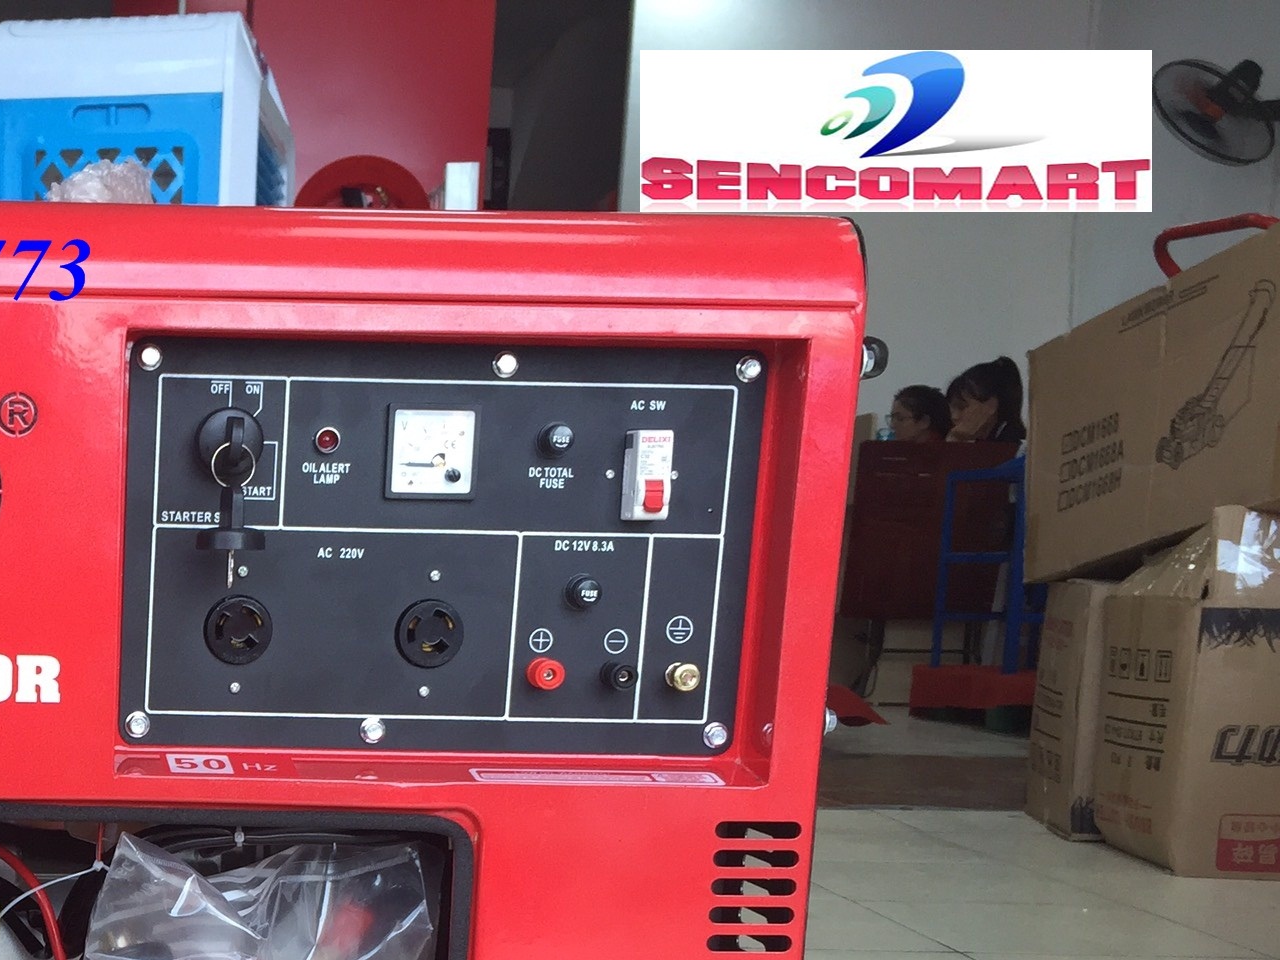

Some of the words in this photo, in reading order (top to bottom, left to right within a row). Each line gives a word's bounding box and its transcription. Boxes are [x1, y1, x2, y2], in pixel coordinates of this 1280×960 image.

[210, 383, 230, 395] OFF
[245, 384, 261, 395] ON
[630, 399, 646, 411] AC
[648, 399, 667, 411] SW
[552, 434, 571, 444] FUSE
[302, 462, 318, 474] OIL
[318, 462, 351, 474] ALERT
[528, 466, 543, 478] DC
[544, 467, 574, 479] TOTAL
[313, 473, 341, 485] LAMP
[539, 477, 565, 489] FUSE
[161, 510, 212, 523] STARTER
[213, 511, 221, 523] S
[554, 539, 570, 551] DC
[571, 540, 592, 552] 12V
[592, 540, 615, 552] 8.3A
[317, 546, 333, 559] AC
[339, 547, 365, 559] 220V
[580, 589, 599, 598] FUSE
[174, 758, 227, 771] 50
[241, 762, 278, 772] Hz
